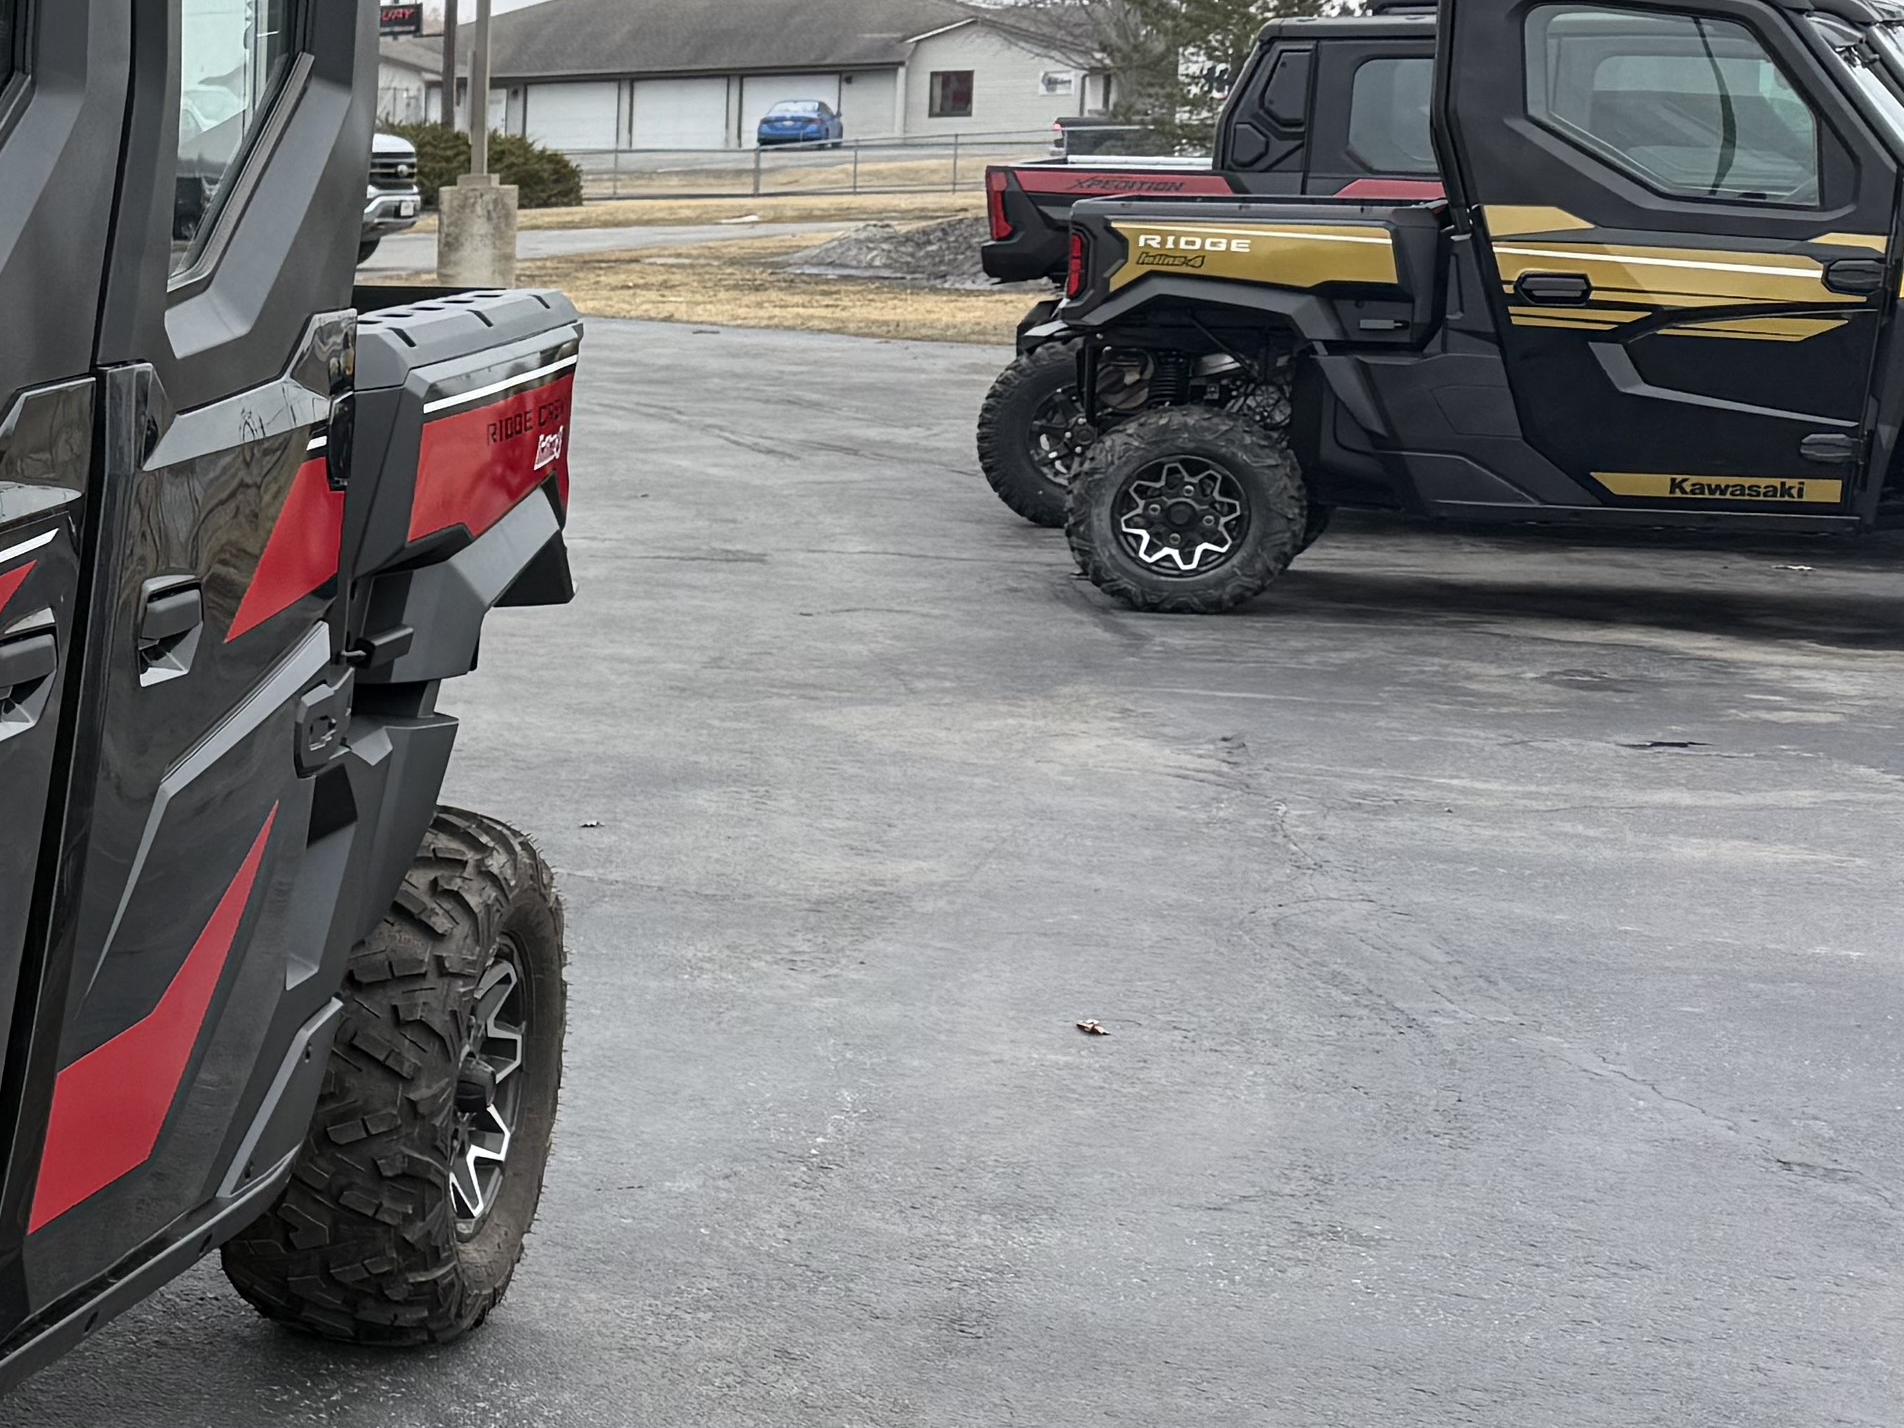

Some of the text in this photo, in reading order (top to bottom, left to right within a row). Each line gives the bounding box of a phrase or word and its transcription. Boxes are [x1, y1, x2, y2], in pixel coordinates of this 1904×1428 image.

[1138, 234, 1251, 253] RIDGE
[487, 409, 533, 446] RIDGE
[1668, 476, 1806, 500] Kawasaki
